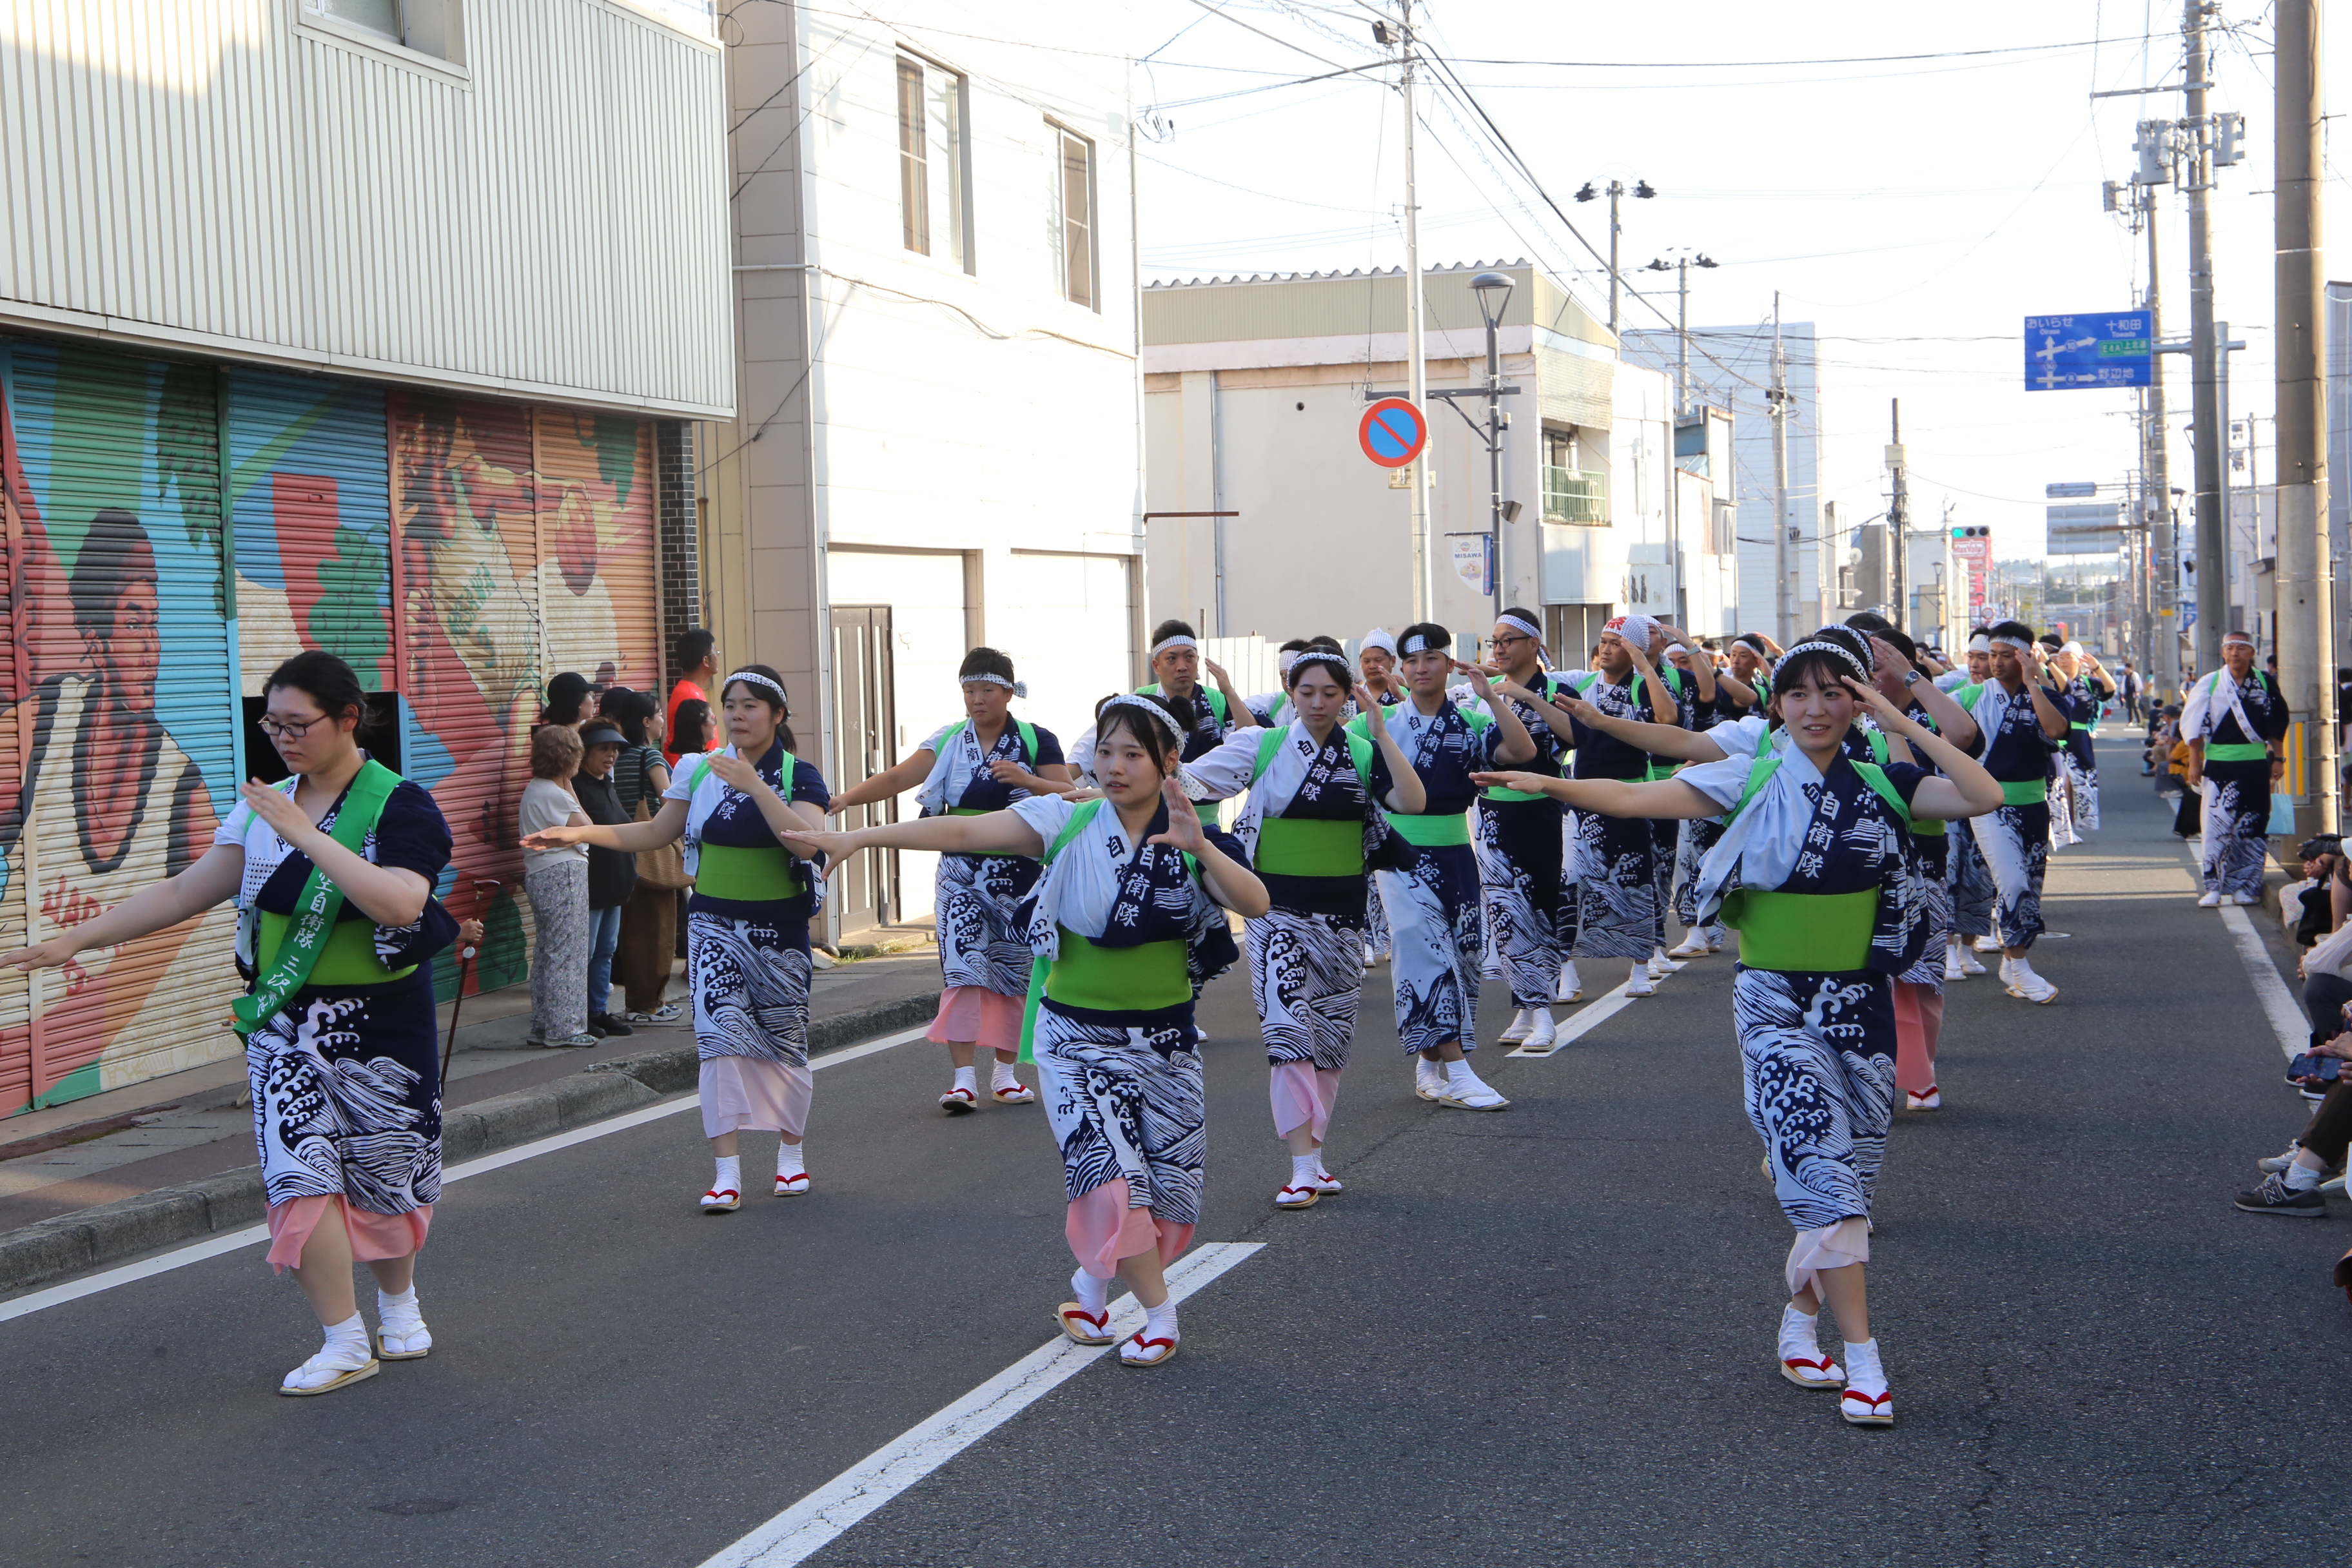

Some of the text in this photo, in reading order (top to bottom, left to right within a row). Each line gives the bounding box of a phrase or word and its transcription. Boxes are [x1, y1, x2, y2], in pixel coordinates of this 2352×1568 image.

[2026, 317, 2073, 329] おいらせ
[2106, 319, 2142, 331] 十和田
[2102, 345, 2121, 353] E4A
[2098, 368, 2134, 380] 野辺地
[2000, 693, 2021, 734] 自衛隊
[977, 734, 1010, 781] 自衛隊
[1418, 716, 1446, 769] 自衛隊
[1301, 745, 1338, 801] 自衛隊
[1796, 790, 1841, 879] 自衛隊
[1114, 843, 1155, 928] 自衛隊
[2263, 1186, 2282, 1204] N
